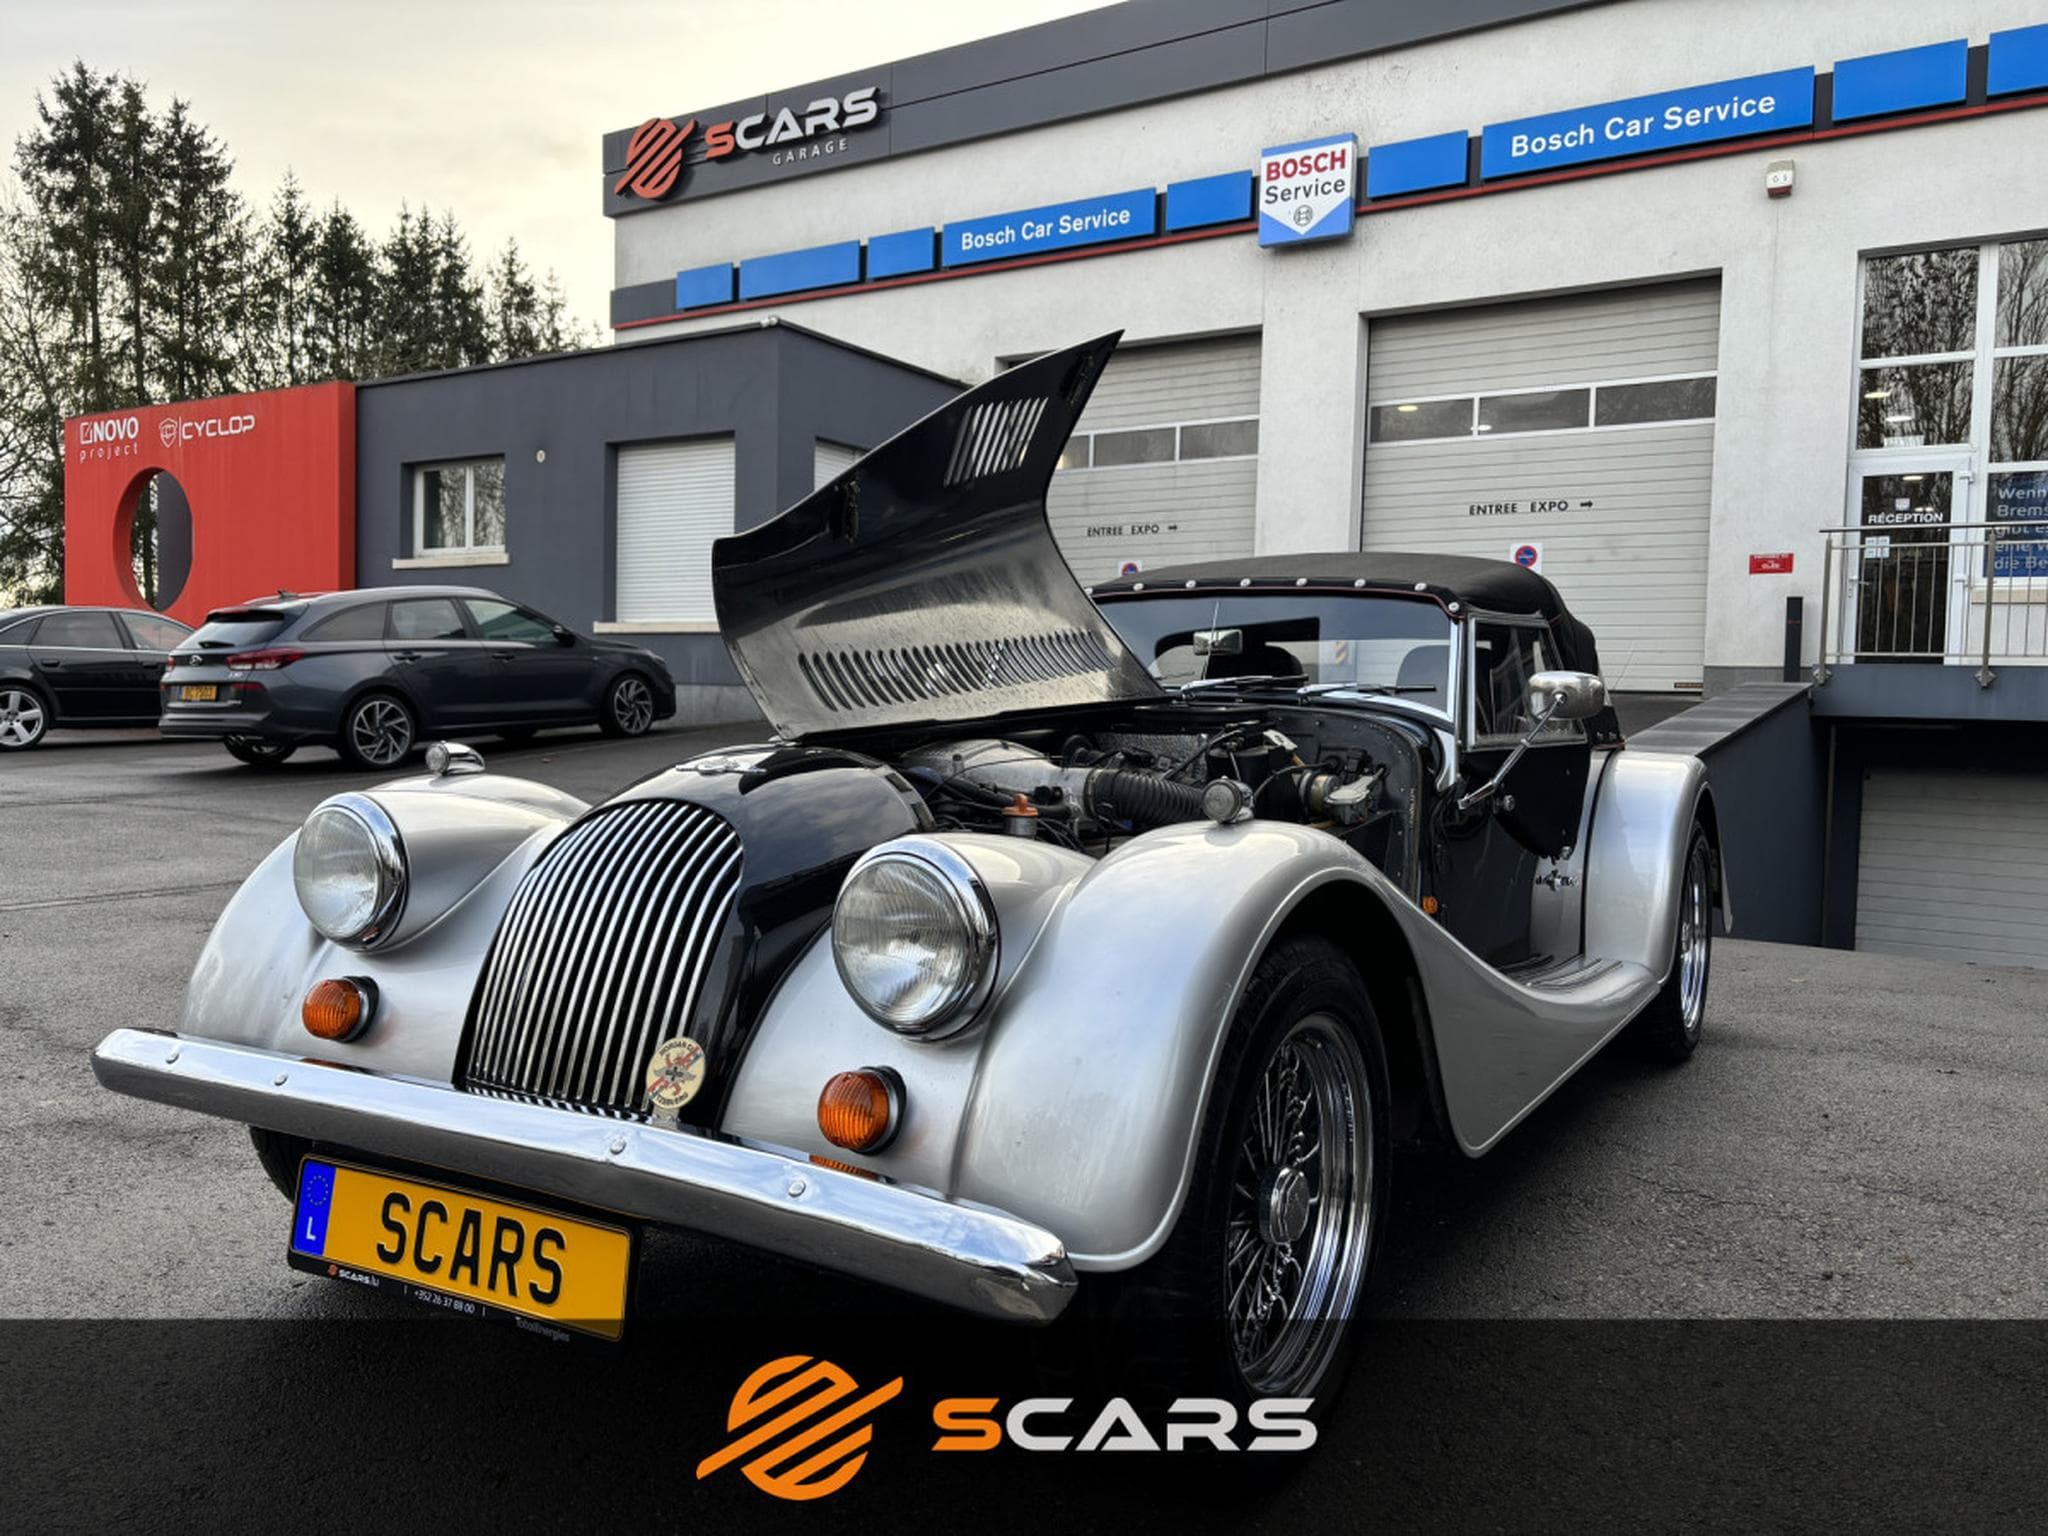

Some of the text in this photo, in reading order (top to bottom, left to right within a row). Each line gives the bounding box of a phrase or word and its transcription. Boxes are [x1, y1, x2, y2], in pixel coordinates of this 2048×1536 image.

[704, 86, 878, 160] SCARS
[1511, 94, 1776, 158] Bosch Car Service
[772, 138, 848, 165] GARAGE
[1266, 148, 1346, 182] BOSCH
[1264, 178, 1346, 205] Service
[961, 208, 1131, 251] Bosch Car Service
[182, 414, 256, 440] CYCLOP
[79, 442, 139, 464] project
[1469, 500, 1569, 516] ENTREE EXPO
[1867, 511, 1944, 525] RÉCEPTION
[1087, 524, 1160, 538] ENTREE EXPO
[305, 1191, 567, 1306] L SCARS
